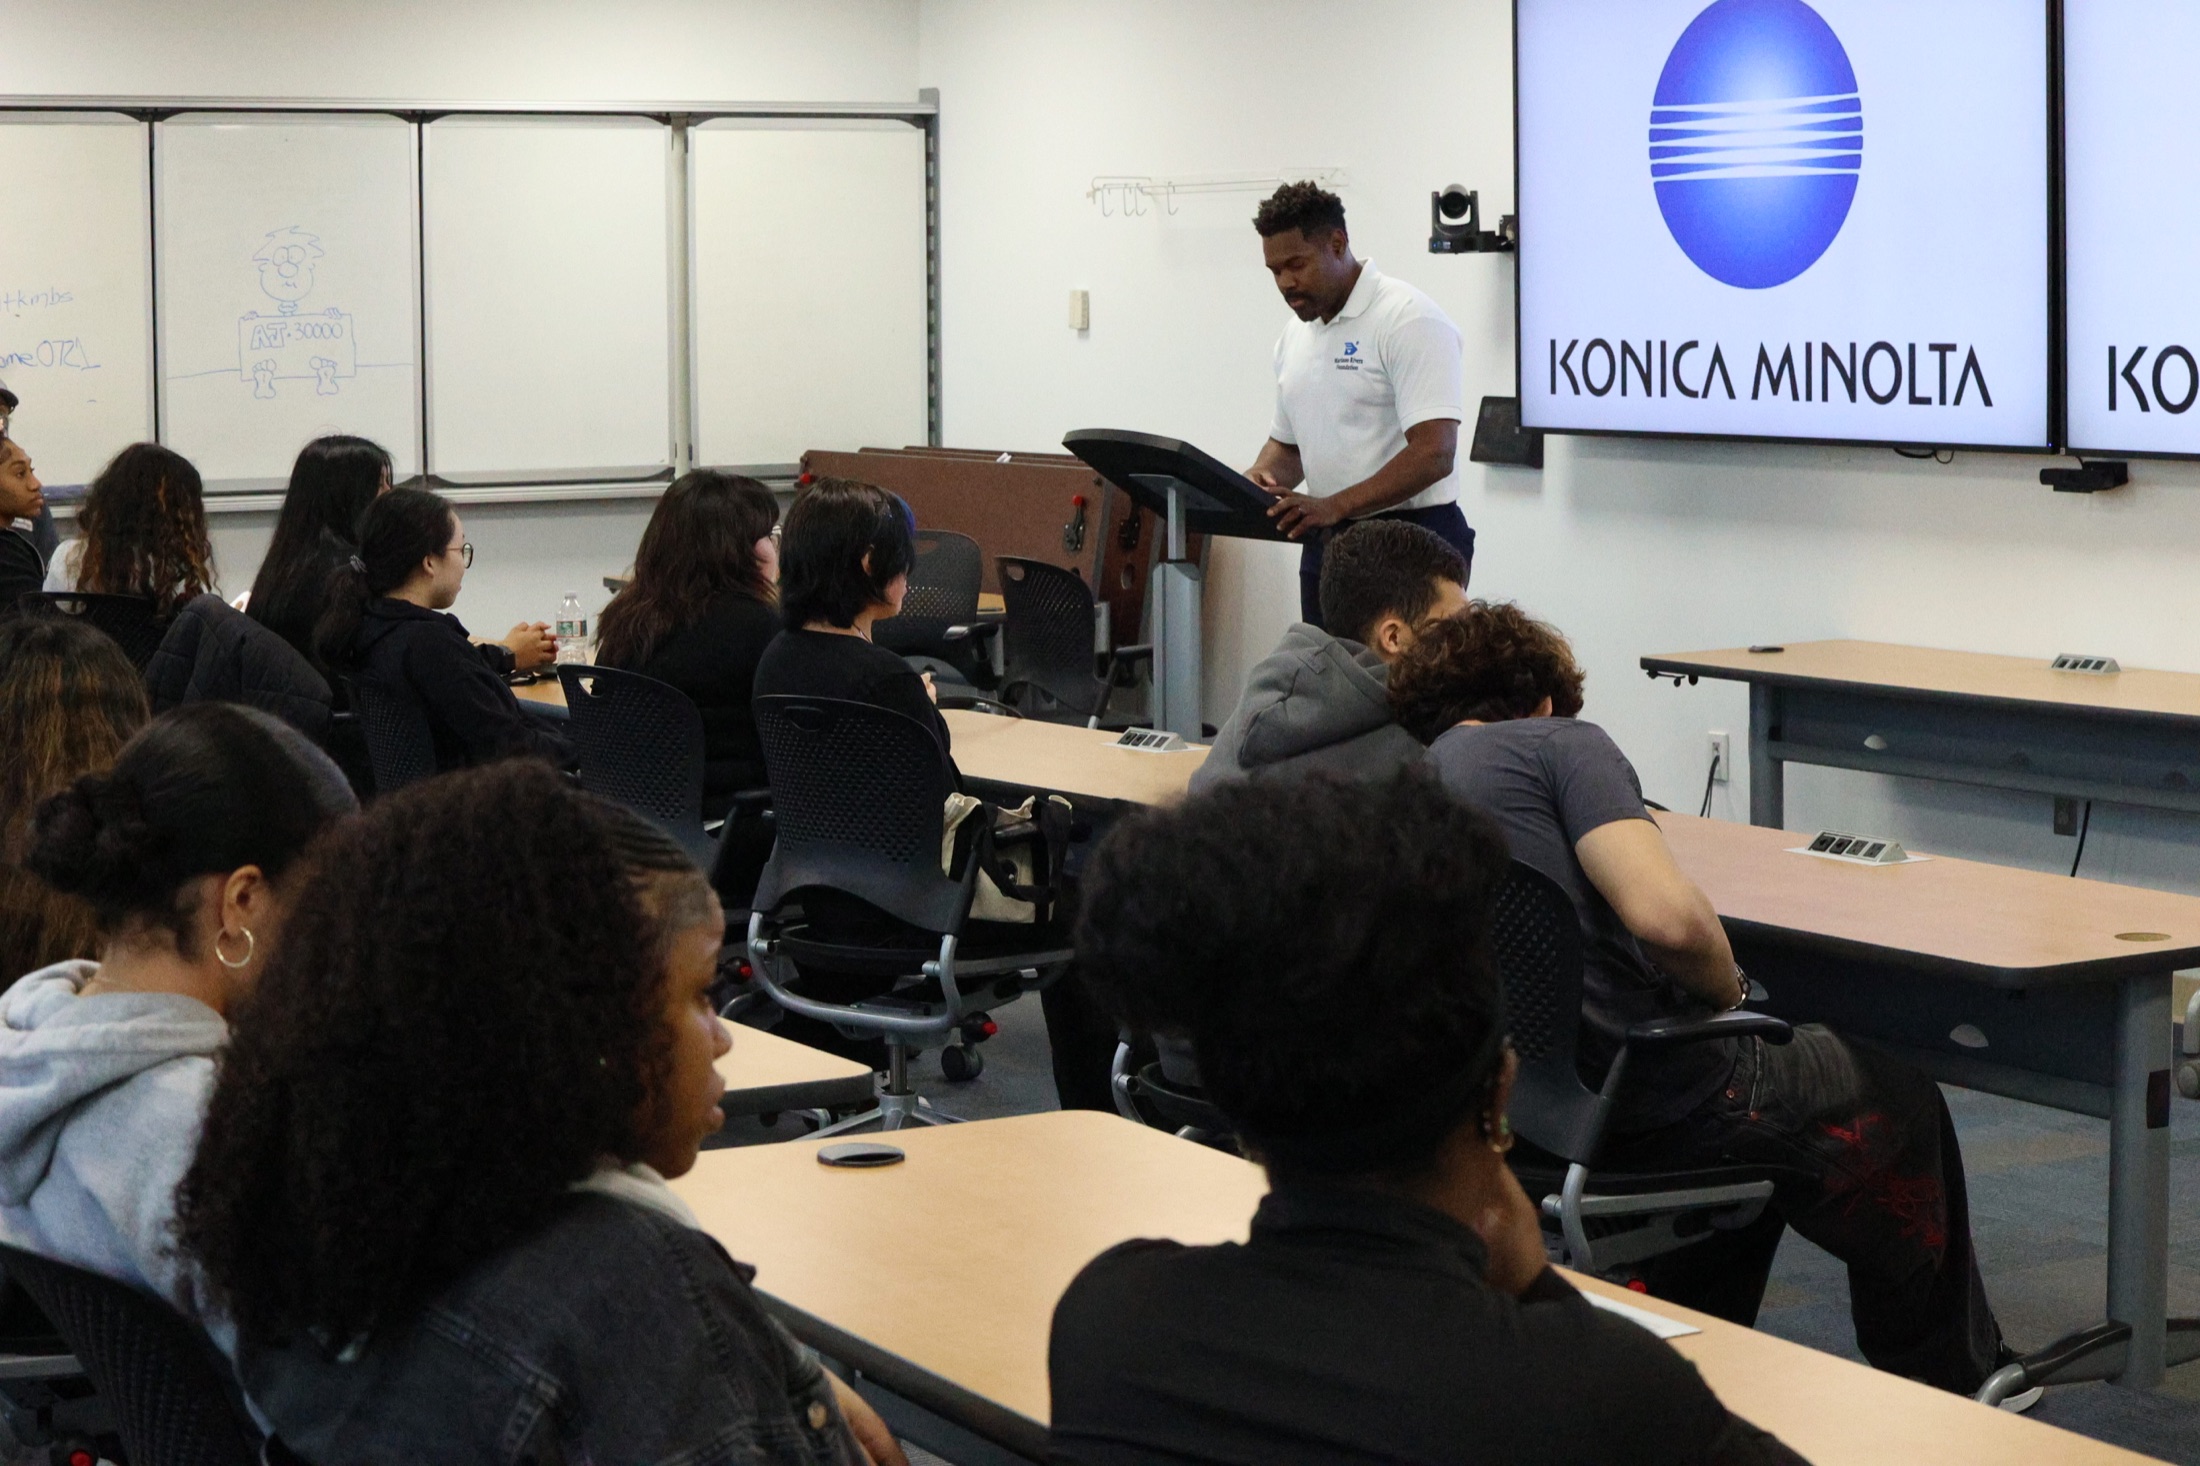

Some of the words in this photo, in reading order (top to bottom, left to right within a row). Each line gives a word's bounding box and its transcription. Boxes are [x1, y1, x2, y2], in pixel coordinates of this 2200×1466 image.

[1550, 338, 1737, 400] KONICA
[1751, 340, 1993, 407] MINOLTA
[2108, 344, 2200, 415] KO
